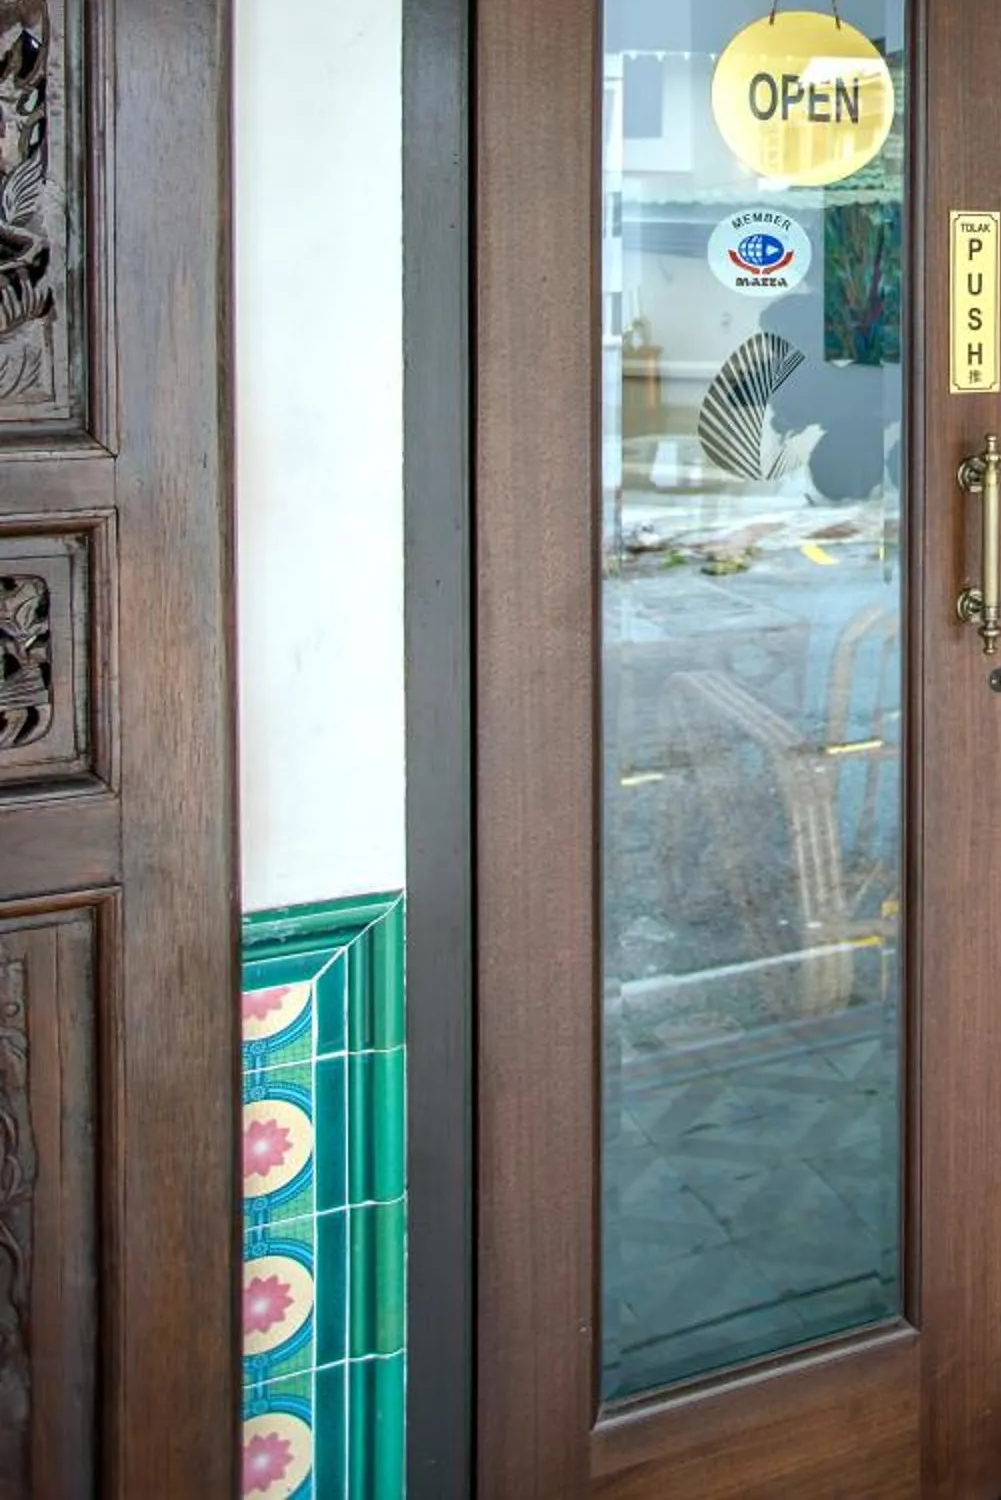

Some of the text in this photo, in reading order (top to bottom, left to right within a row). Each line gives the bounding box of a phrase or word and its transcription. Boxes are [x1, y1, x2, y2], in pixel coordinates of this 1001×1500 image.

[749, 72, 859, 124] OPEN
[731, 211, 791, 231] MEMBER
[961, 223, 991, 233] TOLAK
[967, 238, 983, 366] PUSH
